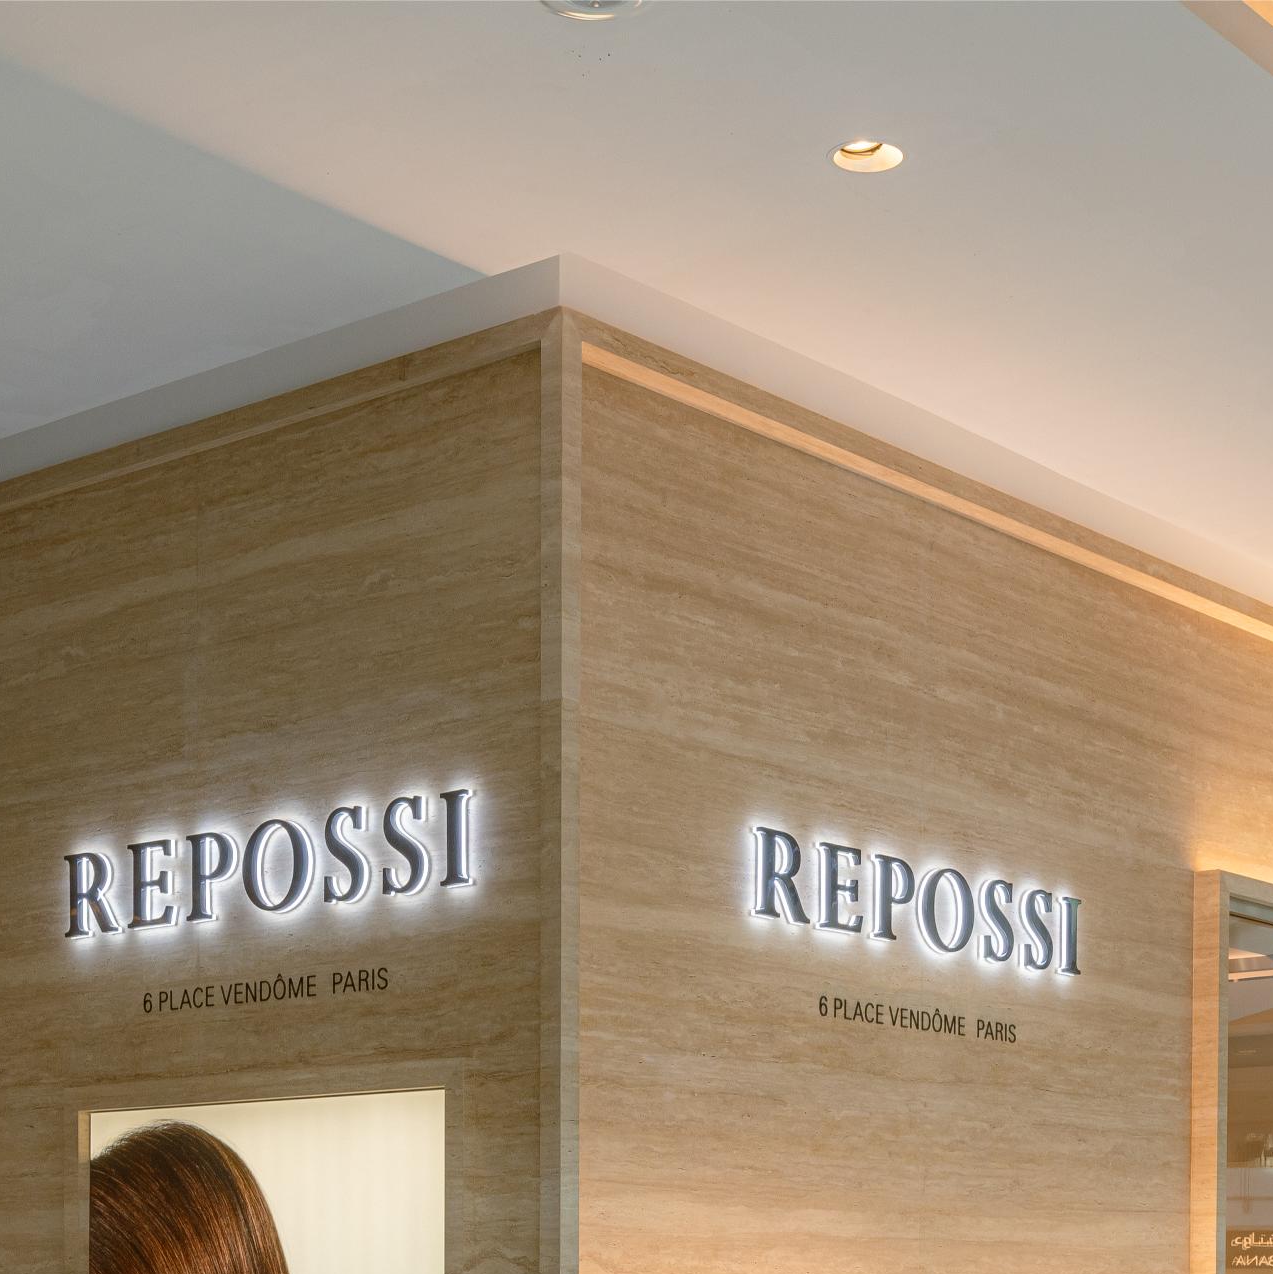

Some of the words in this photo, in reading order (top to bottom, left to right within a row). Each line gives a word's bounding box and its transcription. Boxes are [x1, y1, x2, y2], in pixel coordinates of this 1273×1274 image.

[63, 789, 474, 939] REPOSSI
[750, 825, 1082, 977] REPOSSI
[143, 993, 153, 1013] 6
[159, 985, 216, 1012] PLACE
[221, 973, 318, 1005] VENDÔME
[332, 967, 390, 994] PARIS
[818, 996, 828, 1016] 6
[833, 998, 885, 1025] PLACE
[888, 1005, 966, 1036] VENDÔME
[976, 1019, 1017, 1044] PARIS
